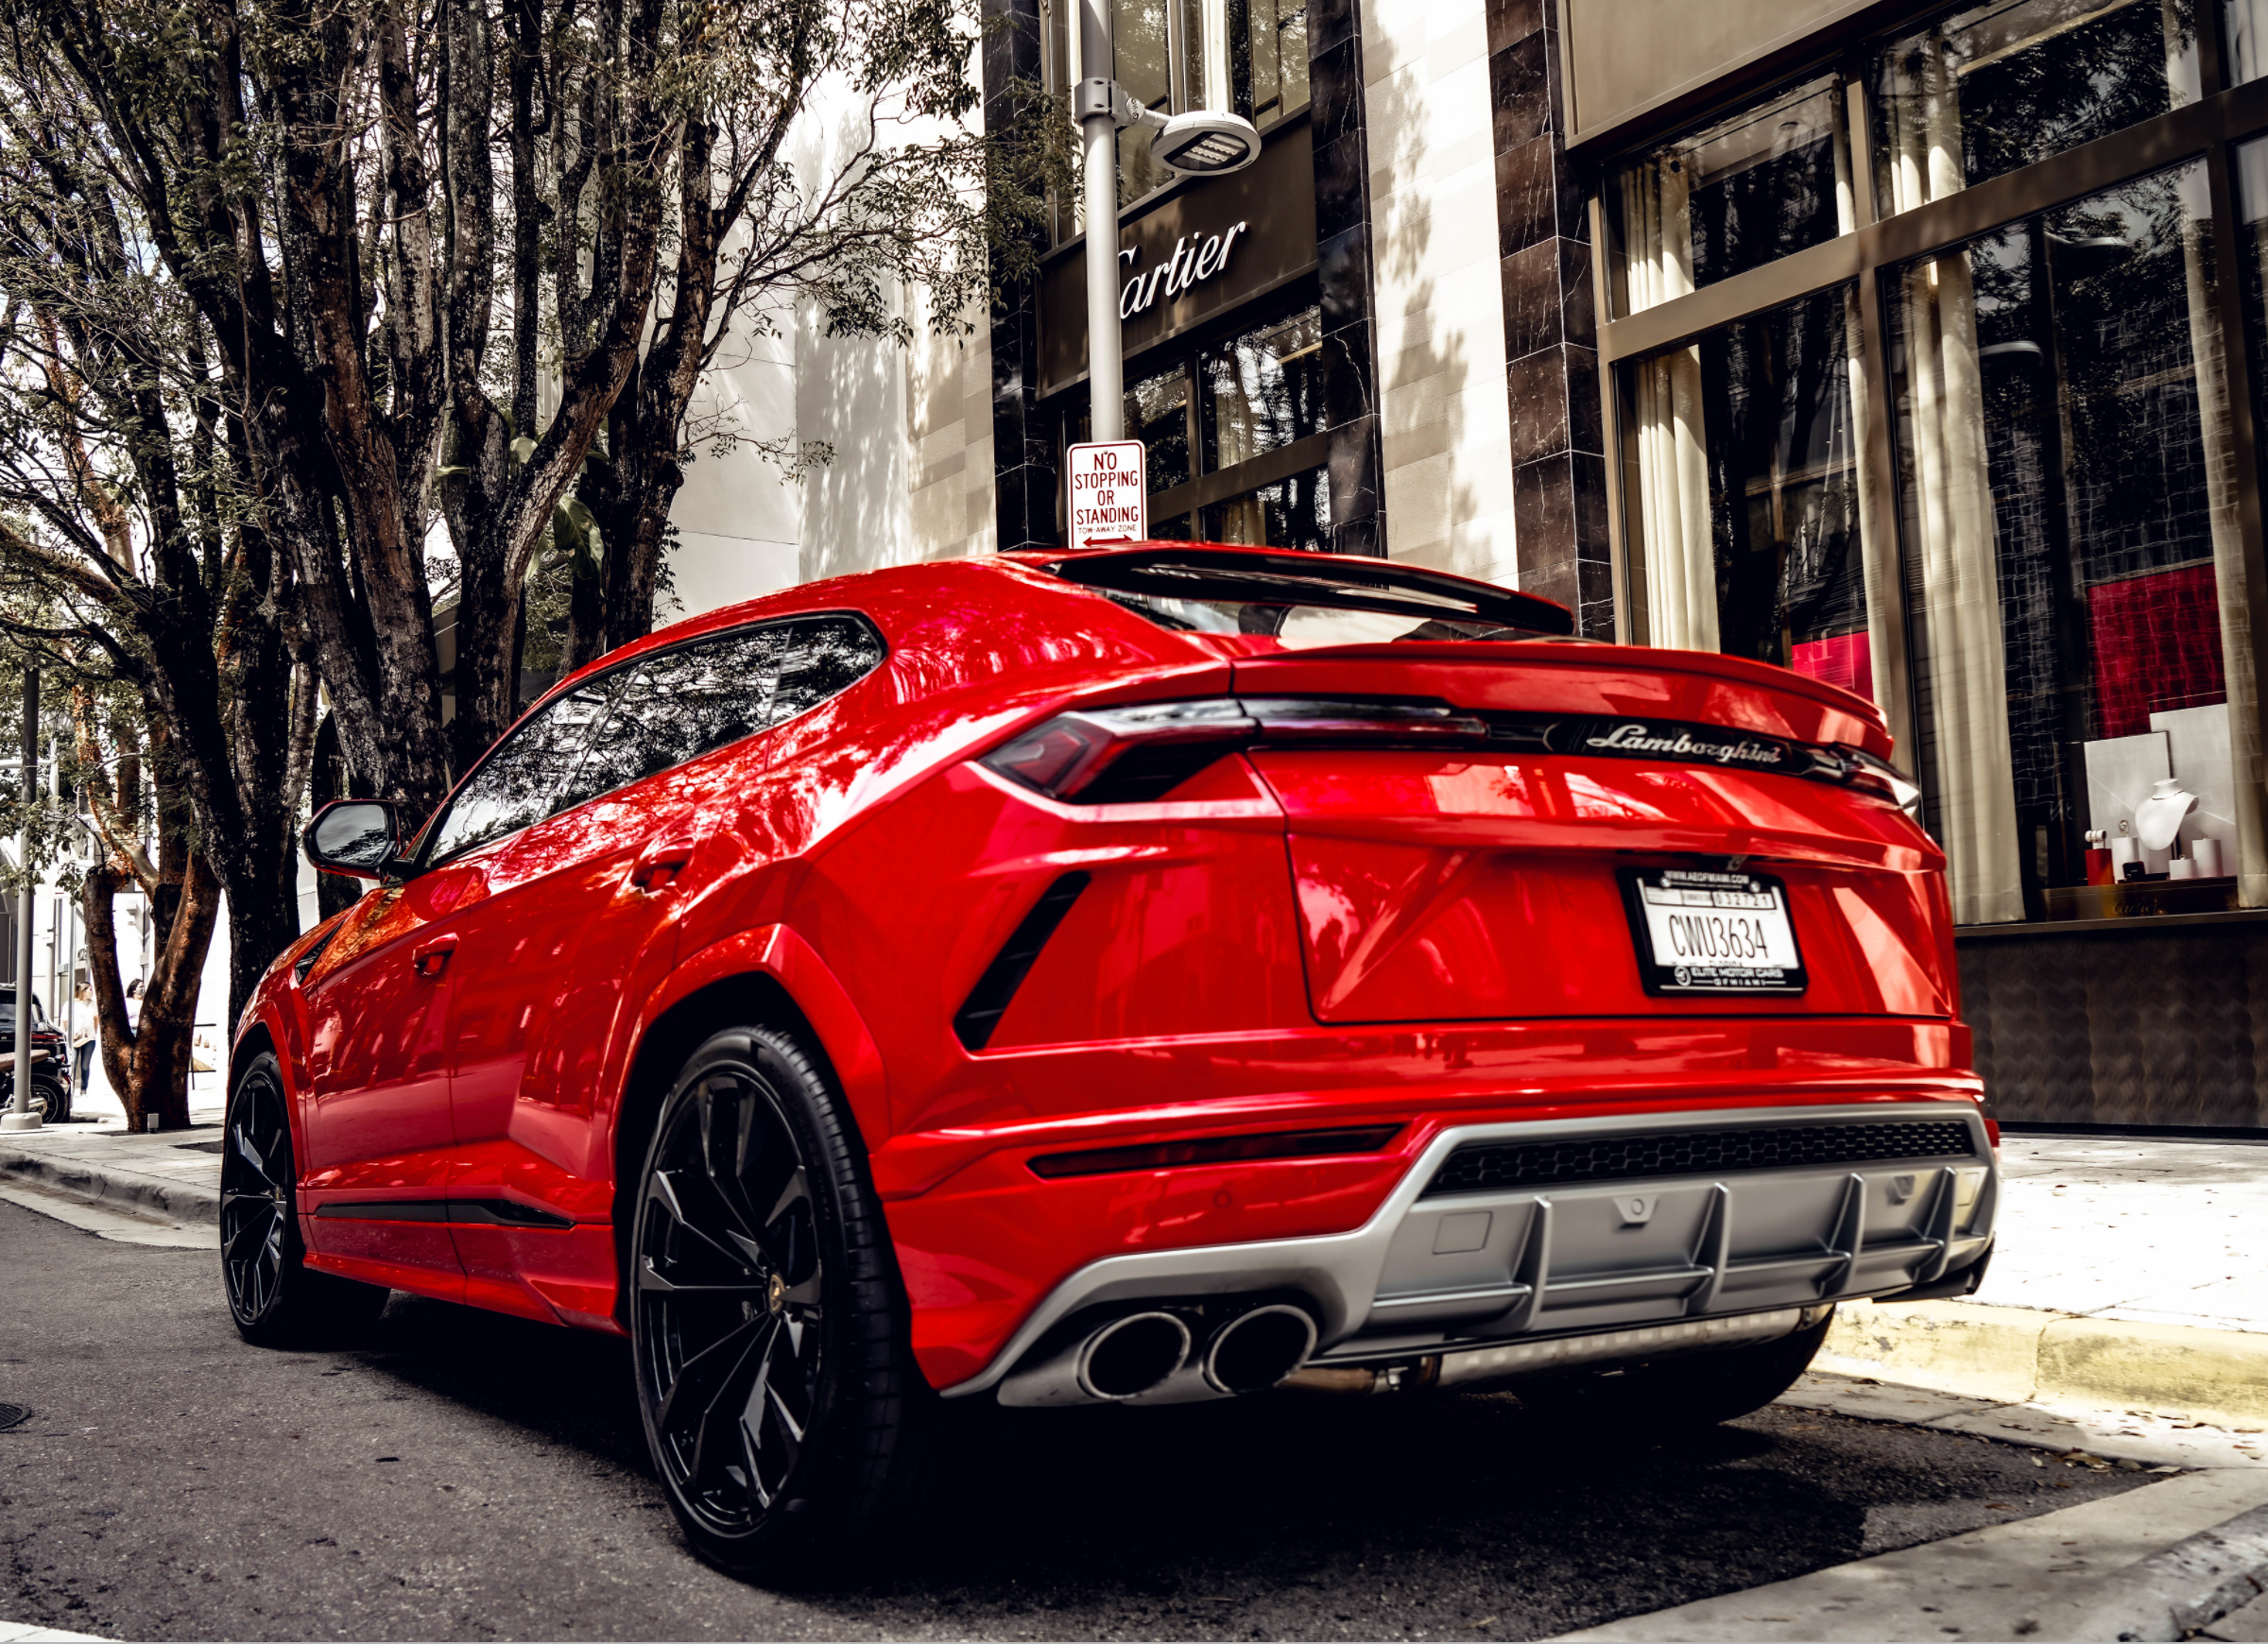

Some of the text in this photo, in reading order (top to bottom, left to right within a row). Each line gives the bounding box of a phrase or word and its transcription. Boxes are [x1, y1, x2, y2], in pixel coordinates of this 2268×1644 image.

[1093, 453, 1117, 471] NO
[1074, 470, 1138, 489] STOPPING
[1097, 489, 1114, 506] OR
[1076, 505, 1139, 525] STANDING
[1078, 525, 1115, 534] TOW-AWAY
[1587, 724, 1781, 763] Lamborghini
[1669, 915, 1768, 959] CWU3634
[1690, 967, 1784, 979] ELITE MOTOR CARS
